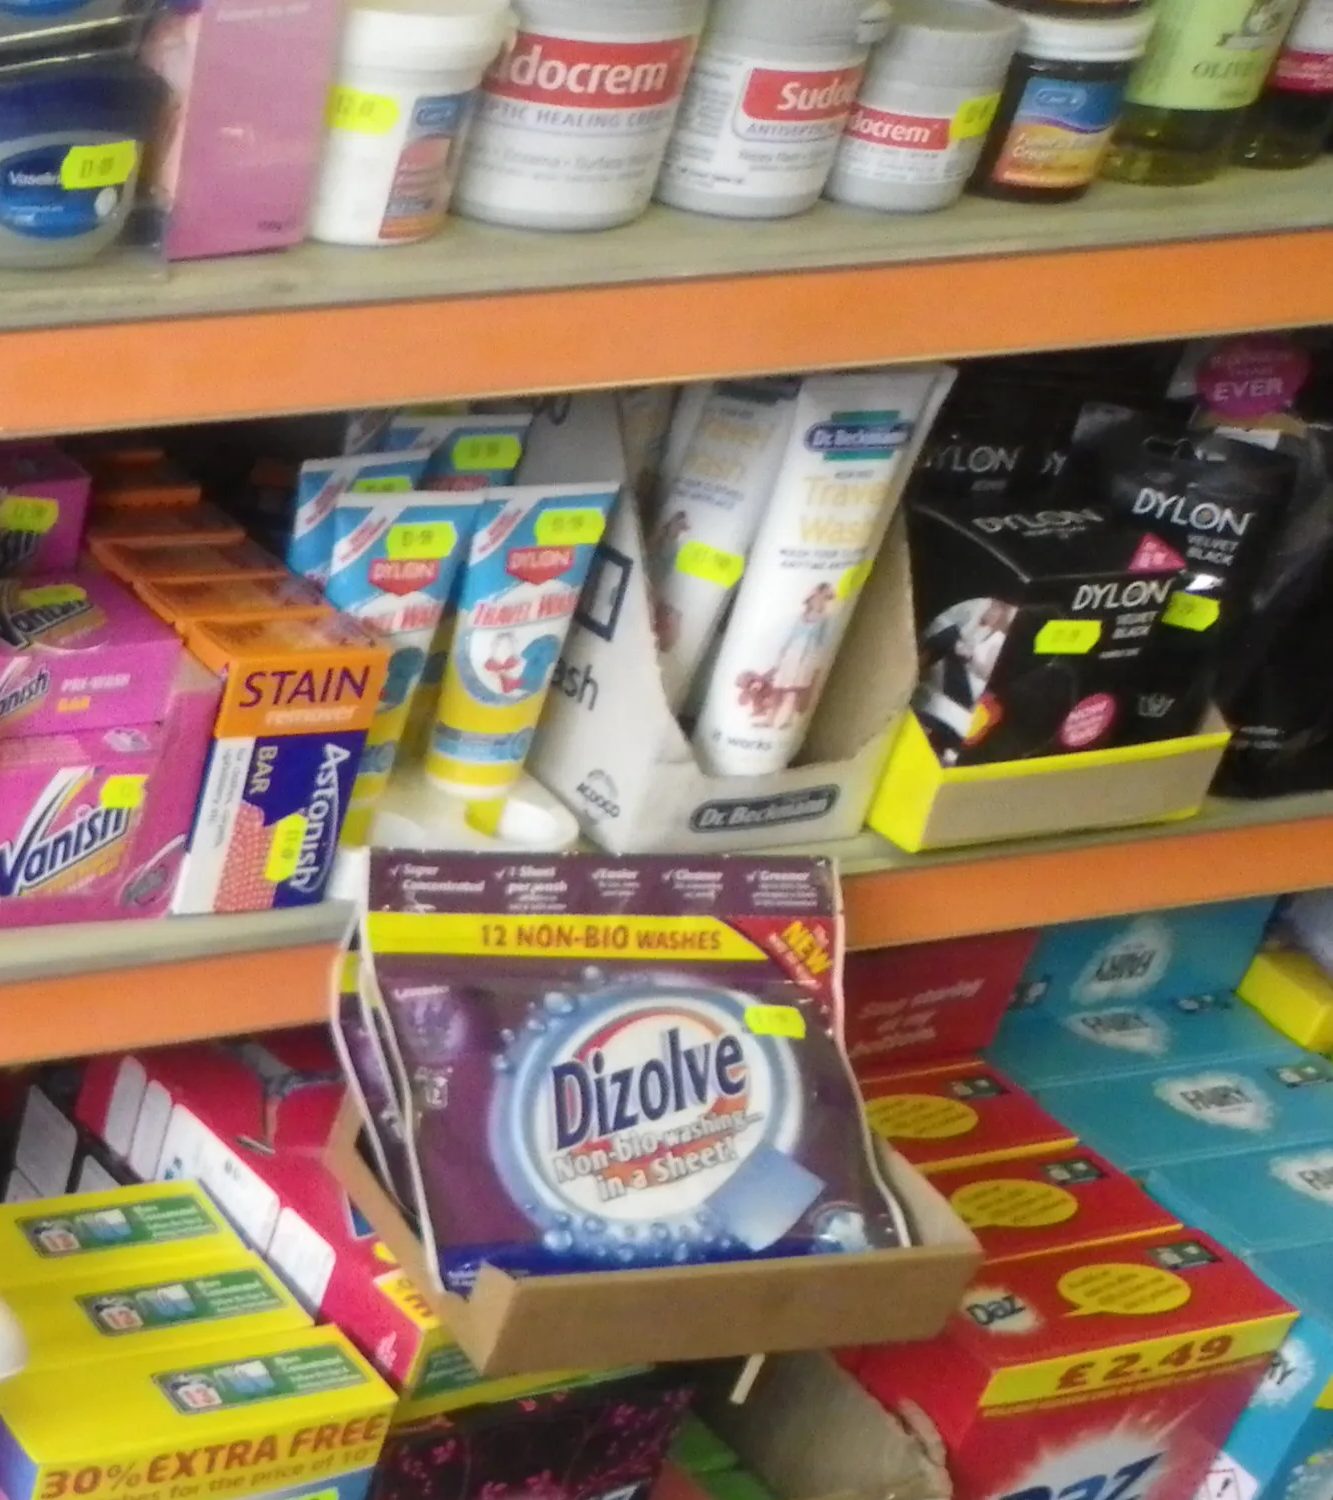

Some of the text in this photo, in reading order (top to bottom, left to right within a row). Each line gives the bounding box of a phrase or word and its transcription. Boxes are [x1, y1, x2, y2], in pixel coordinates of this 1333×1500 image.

[498, 44, 668, 94] docrem
[537, 110, 620, 128] HEALING
[850, 111, 931, 143] docrem
[1211, 377, 1283, 401] EVER
[1133, 487, 1256, 536] DYLON
[1072, 577, 1175, 612] DYLON
[61, 673, 130, 692] PRE-WASH
[239, 666, 371, 708] STAIN
[264, 706, 357, 726] remover
[250, 745, 278, 795] BAR
[289, 743, 351, 893] Astonish
[730, 796, 832, 824] Beckmann
[402, 880, 485, 893] Concentrated
[481, 923, 722, 951] 12 NON-BIO WASHES
[779, 919, 833, 977] NEW
[552, 1027, 748, 1150] Dizolve
[967, 1296, 1026, 1326] Daz
[41, 1412, 387, 1500] 30% EXTRA FREE
